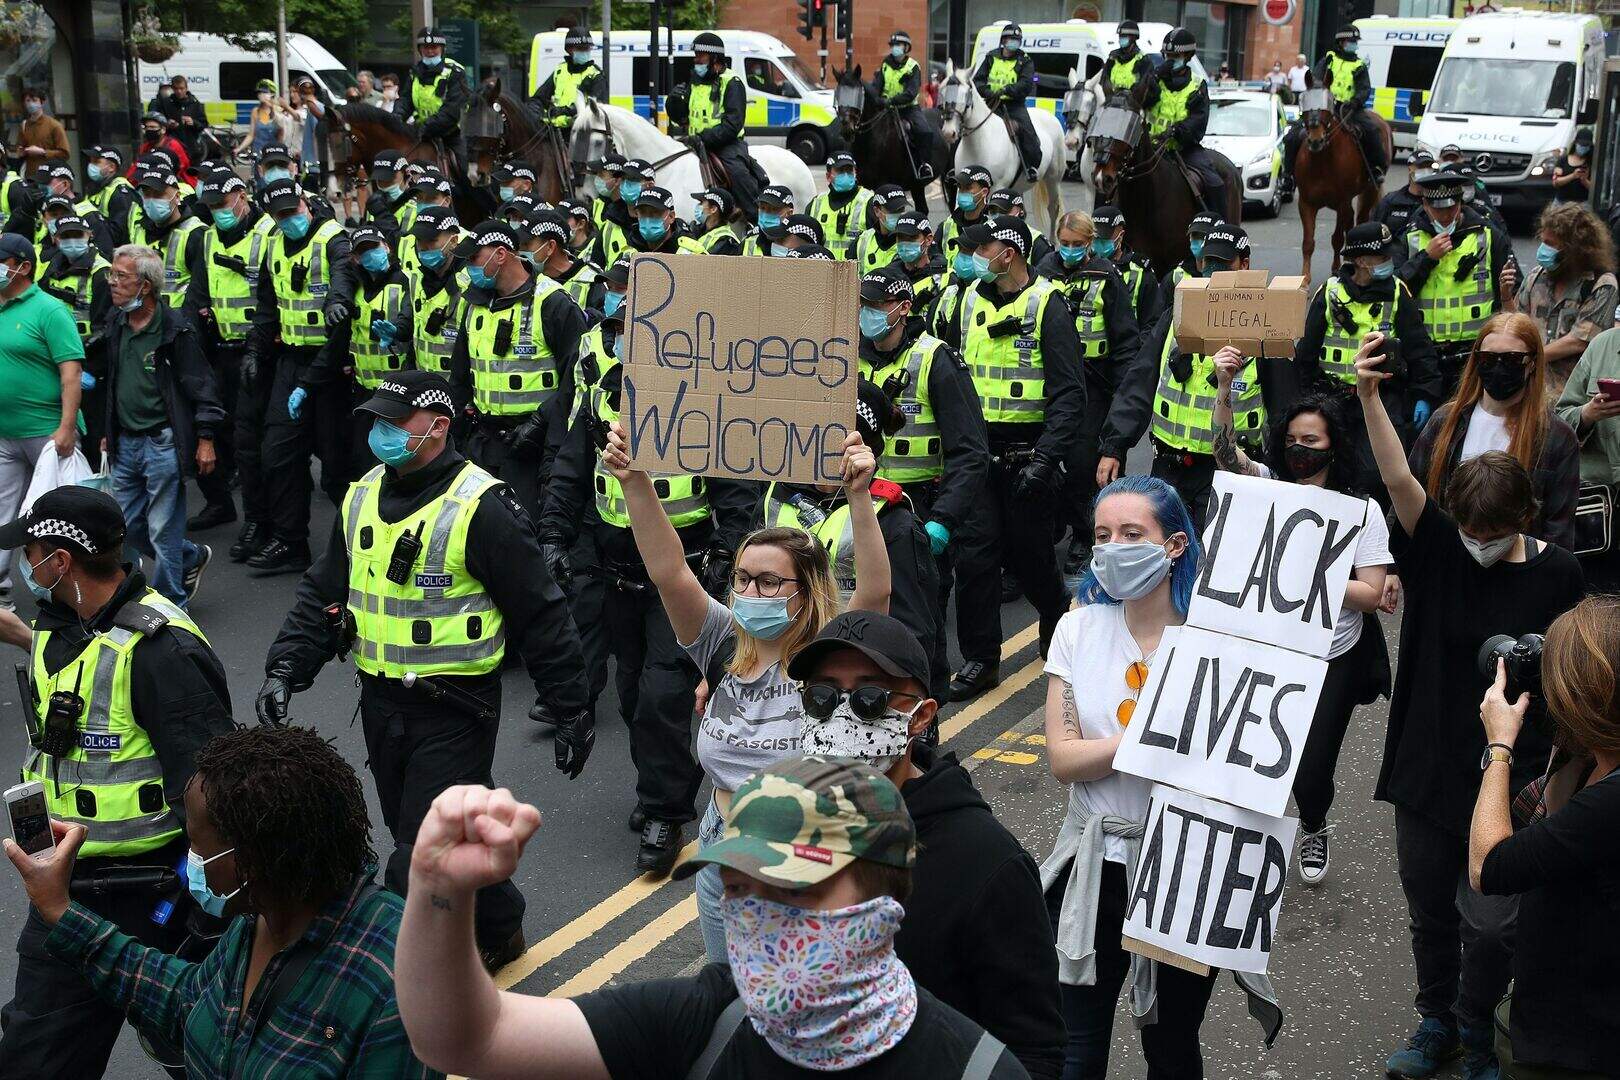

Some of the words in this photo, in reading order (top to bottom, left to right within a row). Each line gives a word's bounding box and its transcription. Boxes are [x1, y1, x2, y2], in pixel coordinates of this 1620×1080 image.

[1020, 39, 1061, 48] LICE
[1459, 133, 1519, 143] POLICE
[271, 187, 292, 198] POLICE
[416, 215, 435, 223] OLICE
[1208, 232, 1234, 241] POLICE
[863, 274, 886, 284] OLICE
[1208, 292, 1220, 302] NO
[1224, 293, 1253, 301] HUMAN
[1257, 293, 1265, 301] IS
[1207, 309, 1272, 328] ILLEGAL
[628, 257, 850, 393] Refugees
[514, 345, 536, 354] POLICE
[1014, 340, 1038, 349] POLICE
[1230, 381, 1247, 391] LICE
[900, 404, 921, 413] OLICE
[623, 375, 848, 481] Welcome
[416, 575, 451, 586] POLICE
[740, 682, 799, 703] MACHIN
[1138, 646, 1307, 779] LIVES
[84, 734, 118, 748] OLICE
[727, 733, 803, 750] FASCIST
[1125, 796, 1287, 953] ATTER
